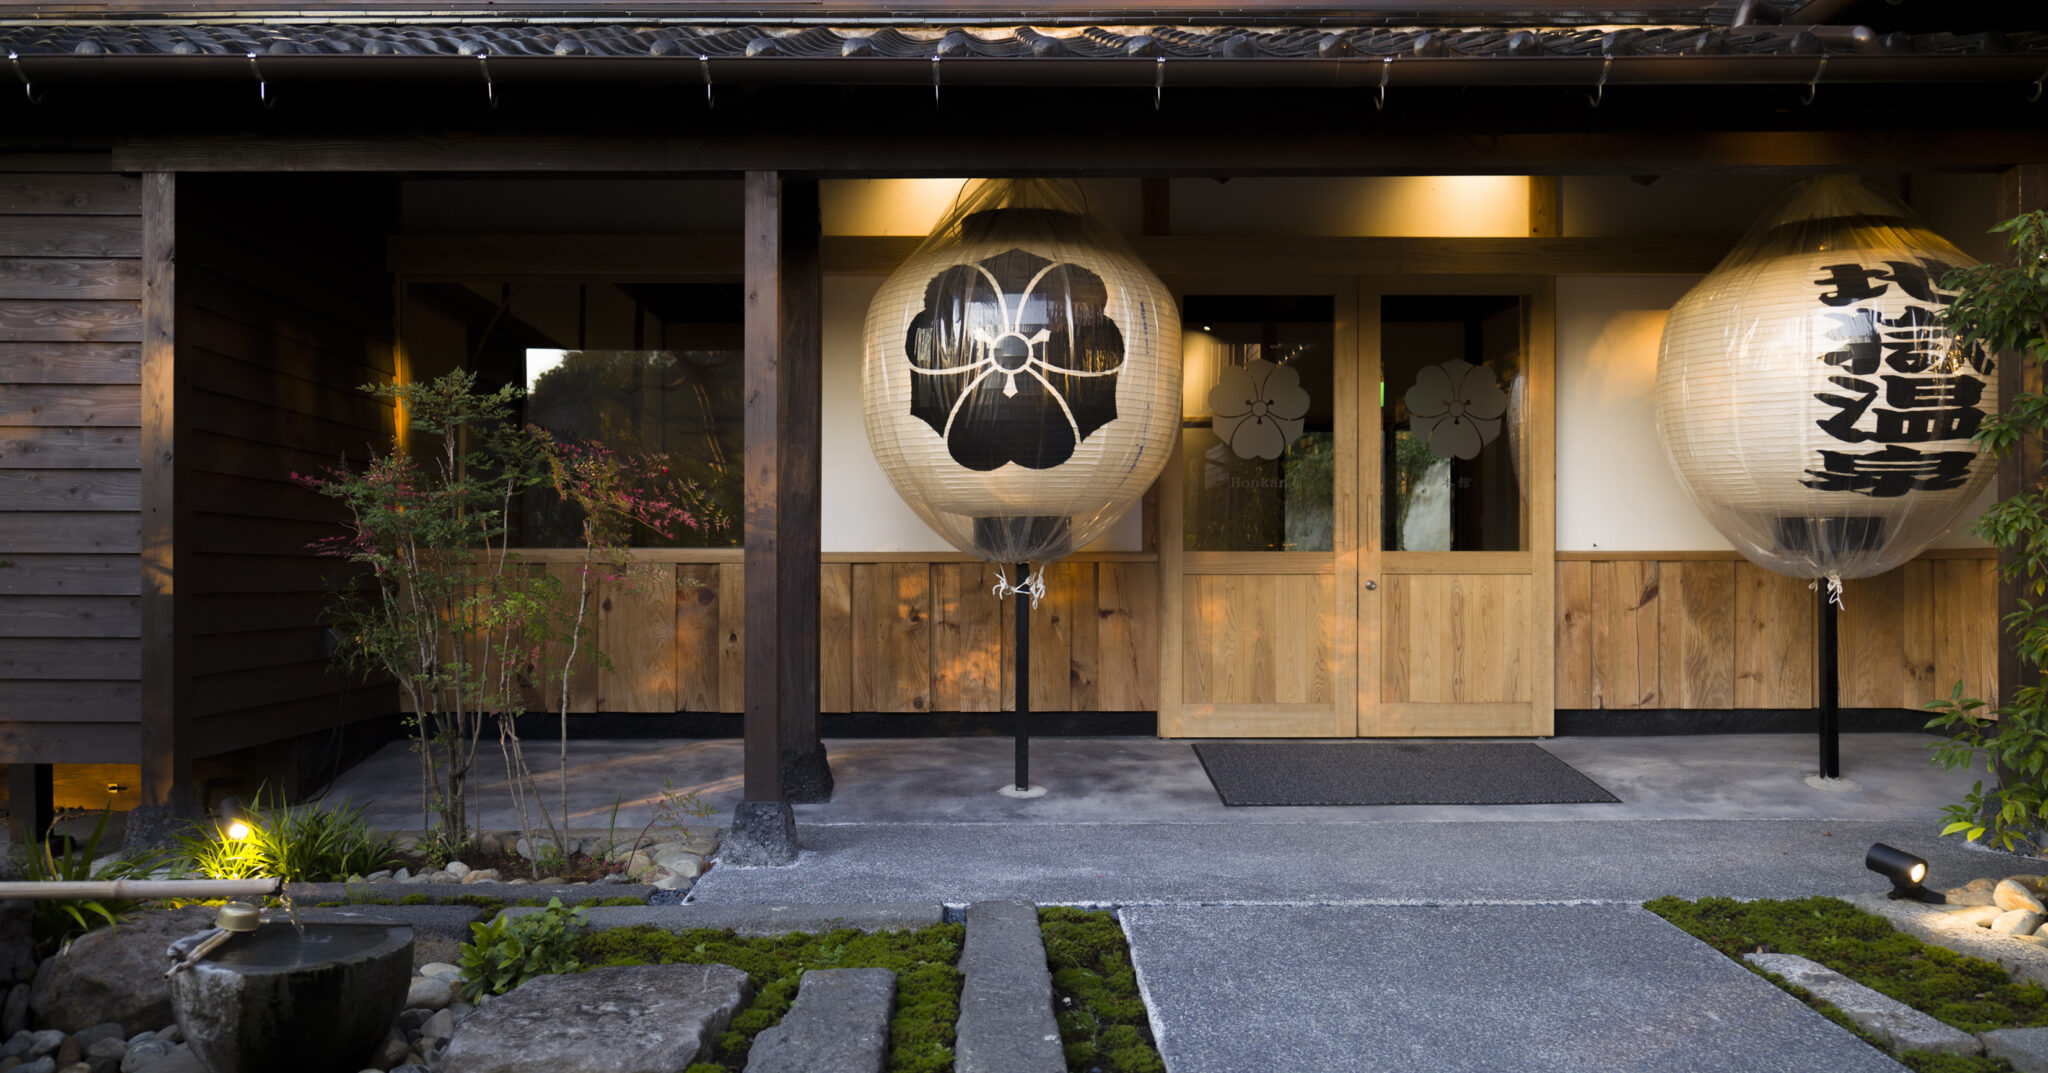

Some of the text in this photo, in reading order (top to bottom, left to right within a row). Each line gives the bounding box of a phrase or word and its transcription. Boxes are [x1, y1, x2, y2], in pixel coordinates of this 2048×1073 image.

[1798, 256, 1995, 497] 地獄温泉
[1231, 476, 1289, 489] Honkan
